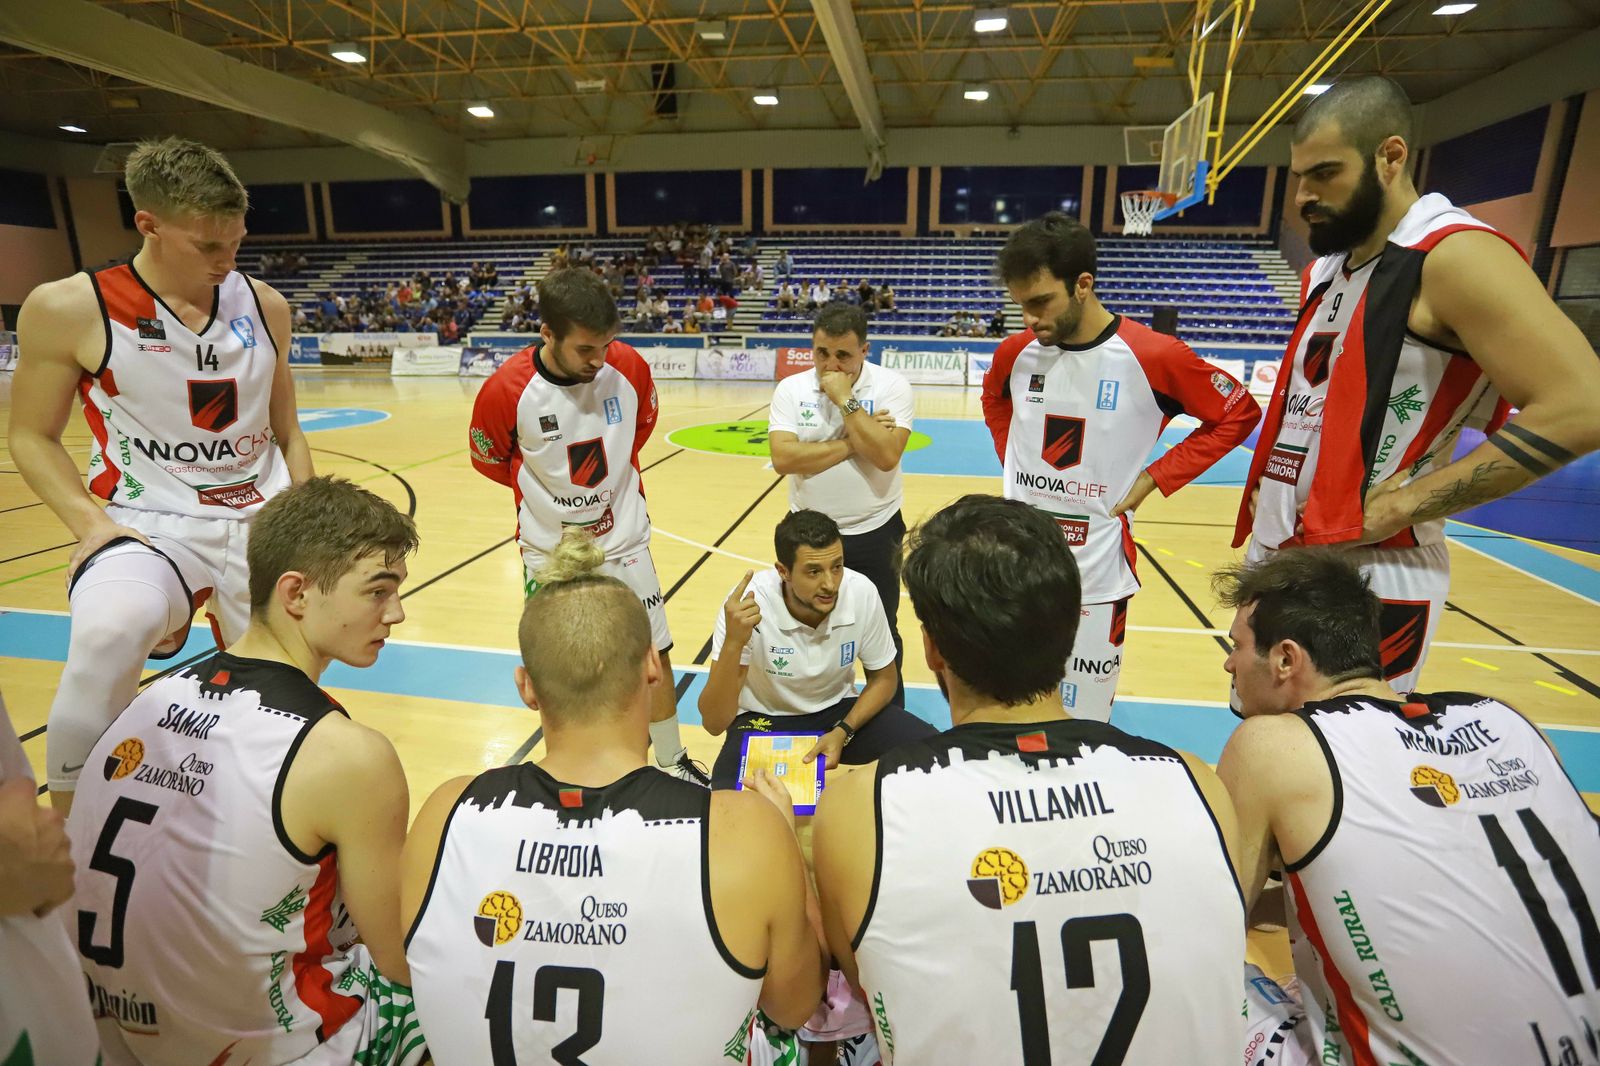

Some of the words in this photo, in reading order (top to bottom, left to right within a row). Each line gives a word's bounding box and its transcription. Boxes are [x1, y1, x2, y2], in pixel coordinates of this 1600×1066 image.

[1328, 292, 1343, 322] 9
[196, 344, 219, 371] 14
[885, 353, 900, 369] LA
[904, 353, 961, 370] PITANZA
[1016, 471, 1108, 498] INNOVACHEF
[1266, 462, 1297, 479] ZAMORA
[157, 703, 221, 740] SAMAR
[133, 763, 205, 797] ZAMORANO
[1459, 769, 1540, 799] ZAMORANO
[988, 780, 1114, 824] VILLAMIL
[515, 839, 604, 878] LIBROIA
[78, 796, 160, 969] 5
[1033, 860, 1152, 896] ZAMORANO
[1477, 807, 1600, 997] 11
[523, 919, 627, 946] ZAMORANO
[1333, 889, 1380, 963] RURAL
[1368, 968, 1405, 1022] CAJA
